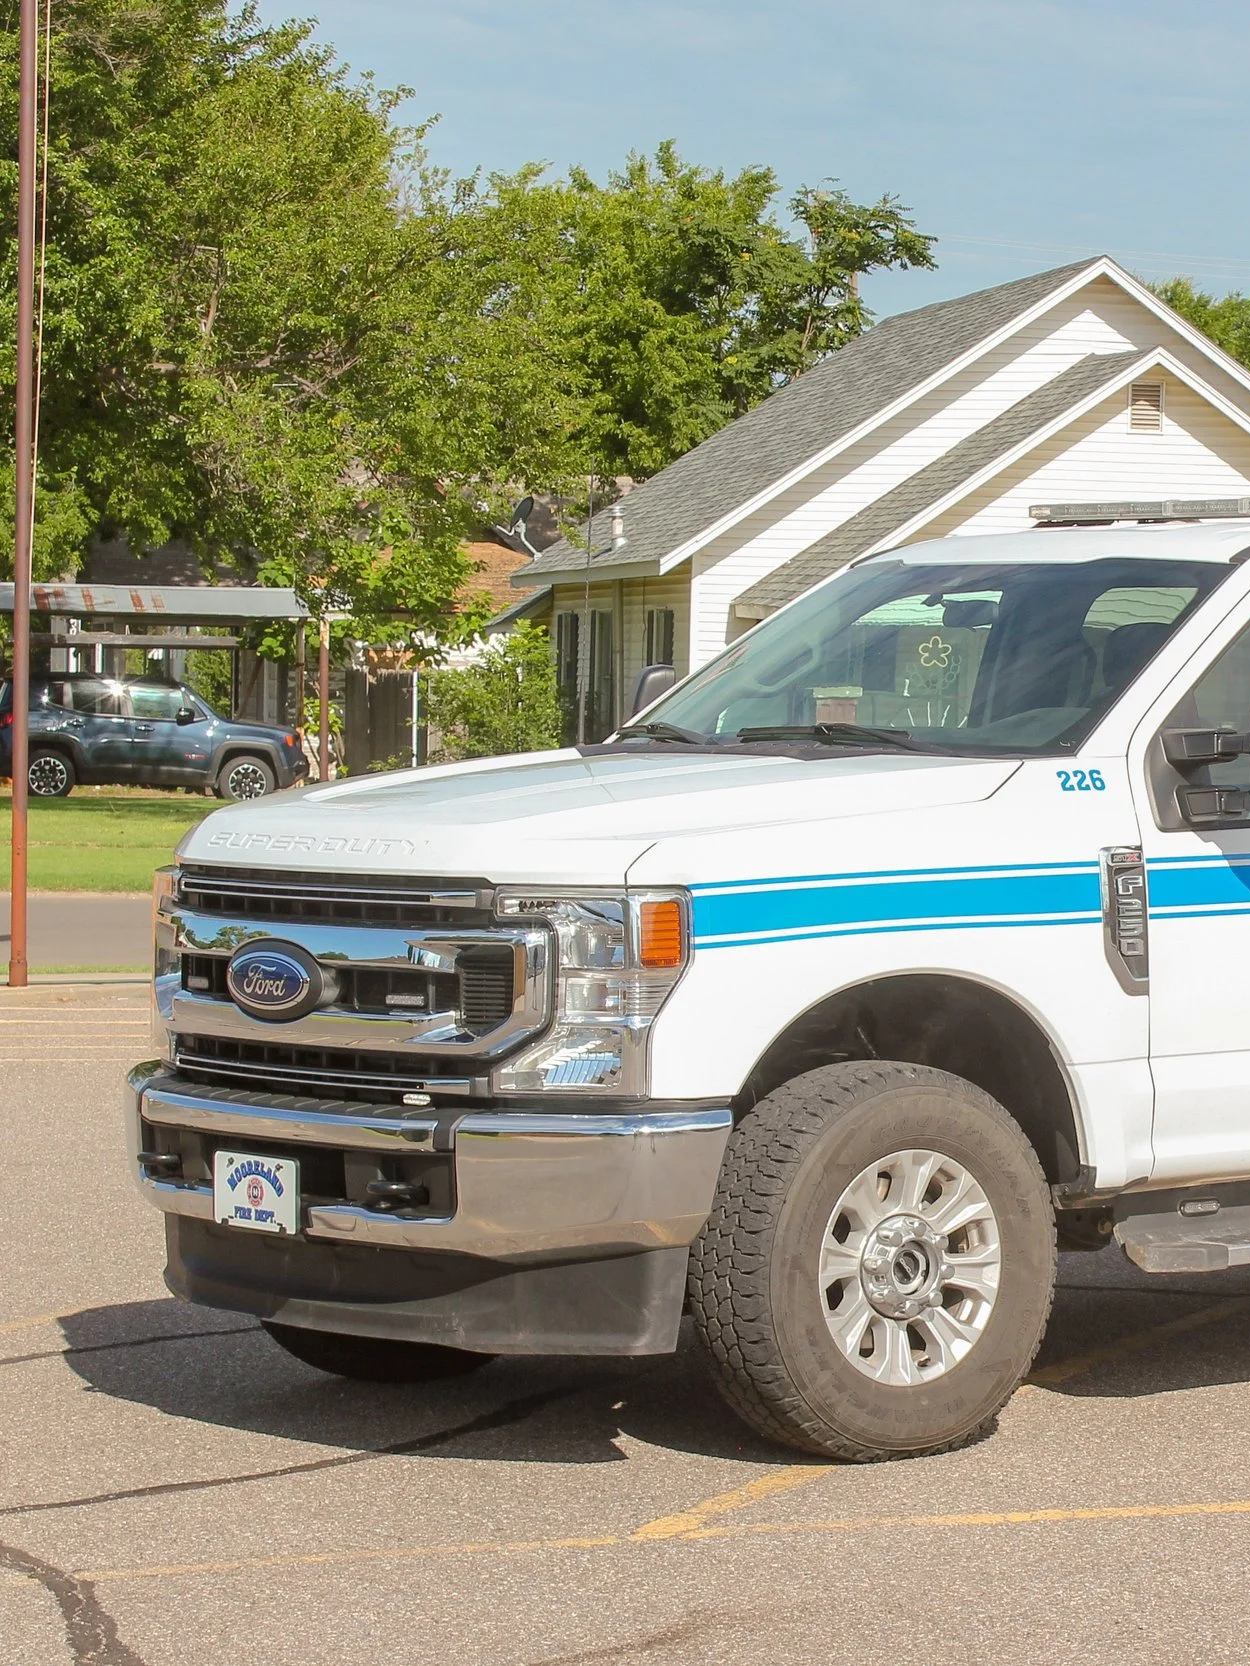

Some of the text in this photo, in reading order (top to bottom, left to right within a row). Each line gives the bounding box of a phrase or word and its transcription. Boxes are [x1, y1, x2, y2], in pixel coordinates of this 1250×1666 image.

[1056, 769, 1106, 791] 226
[208, 832, 419, 856] SUPER DUTY
[243, 963, 286, 996] Ford
[227, 1160, 284, 1197] MOORELAND
[234, 1206, 252, 1220] FIRE
